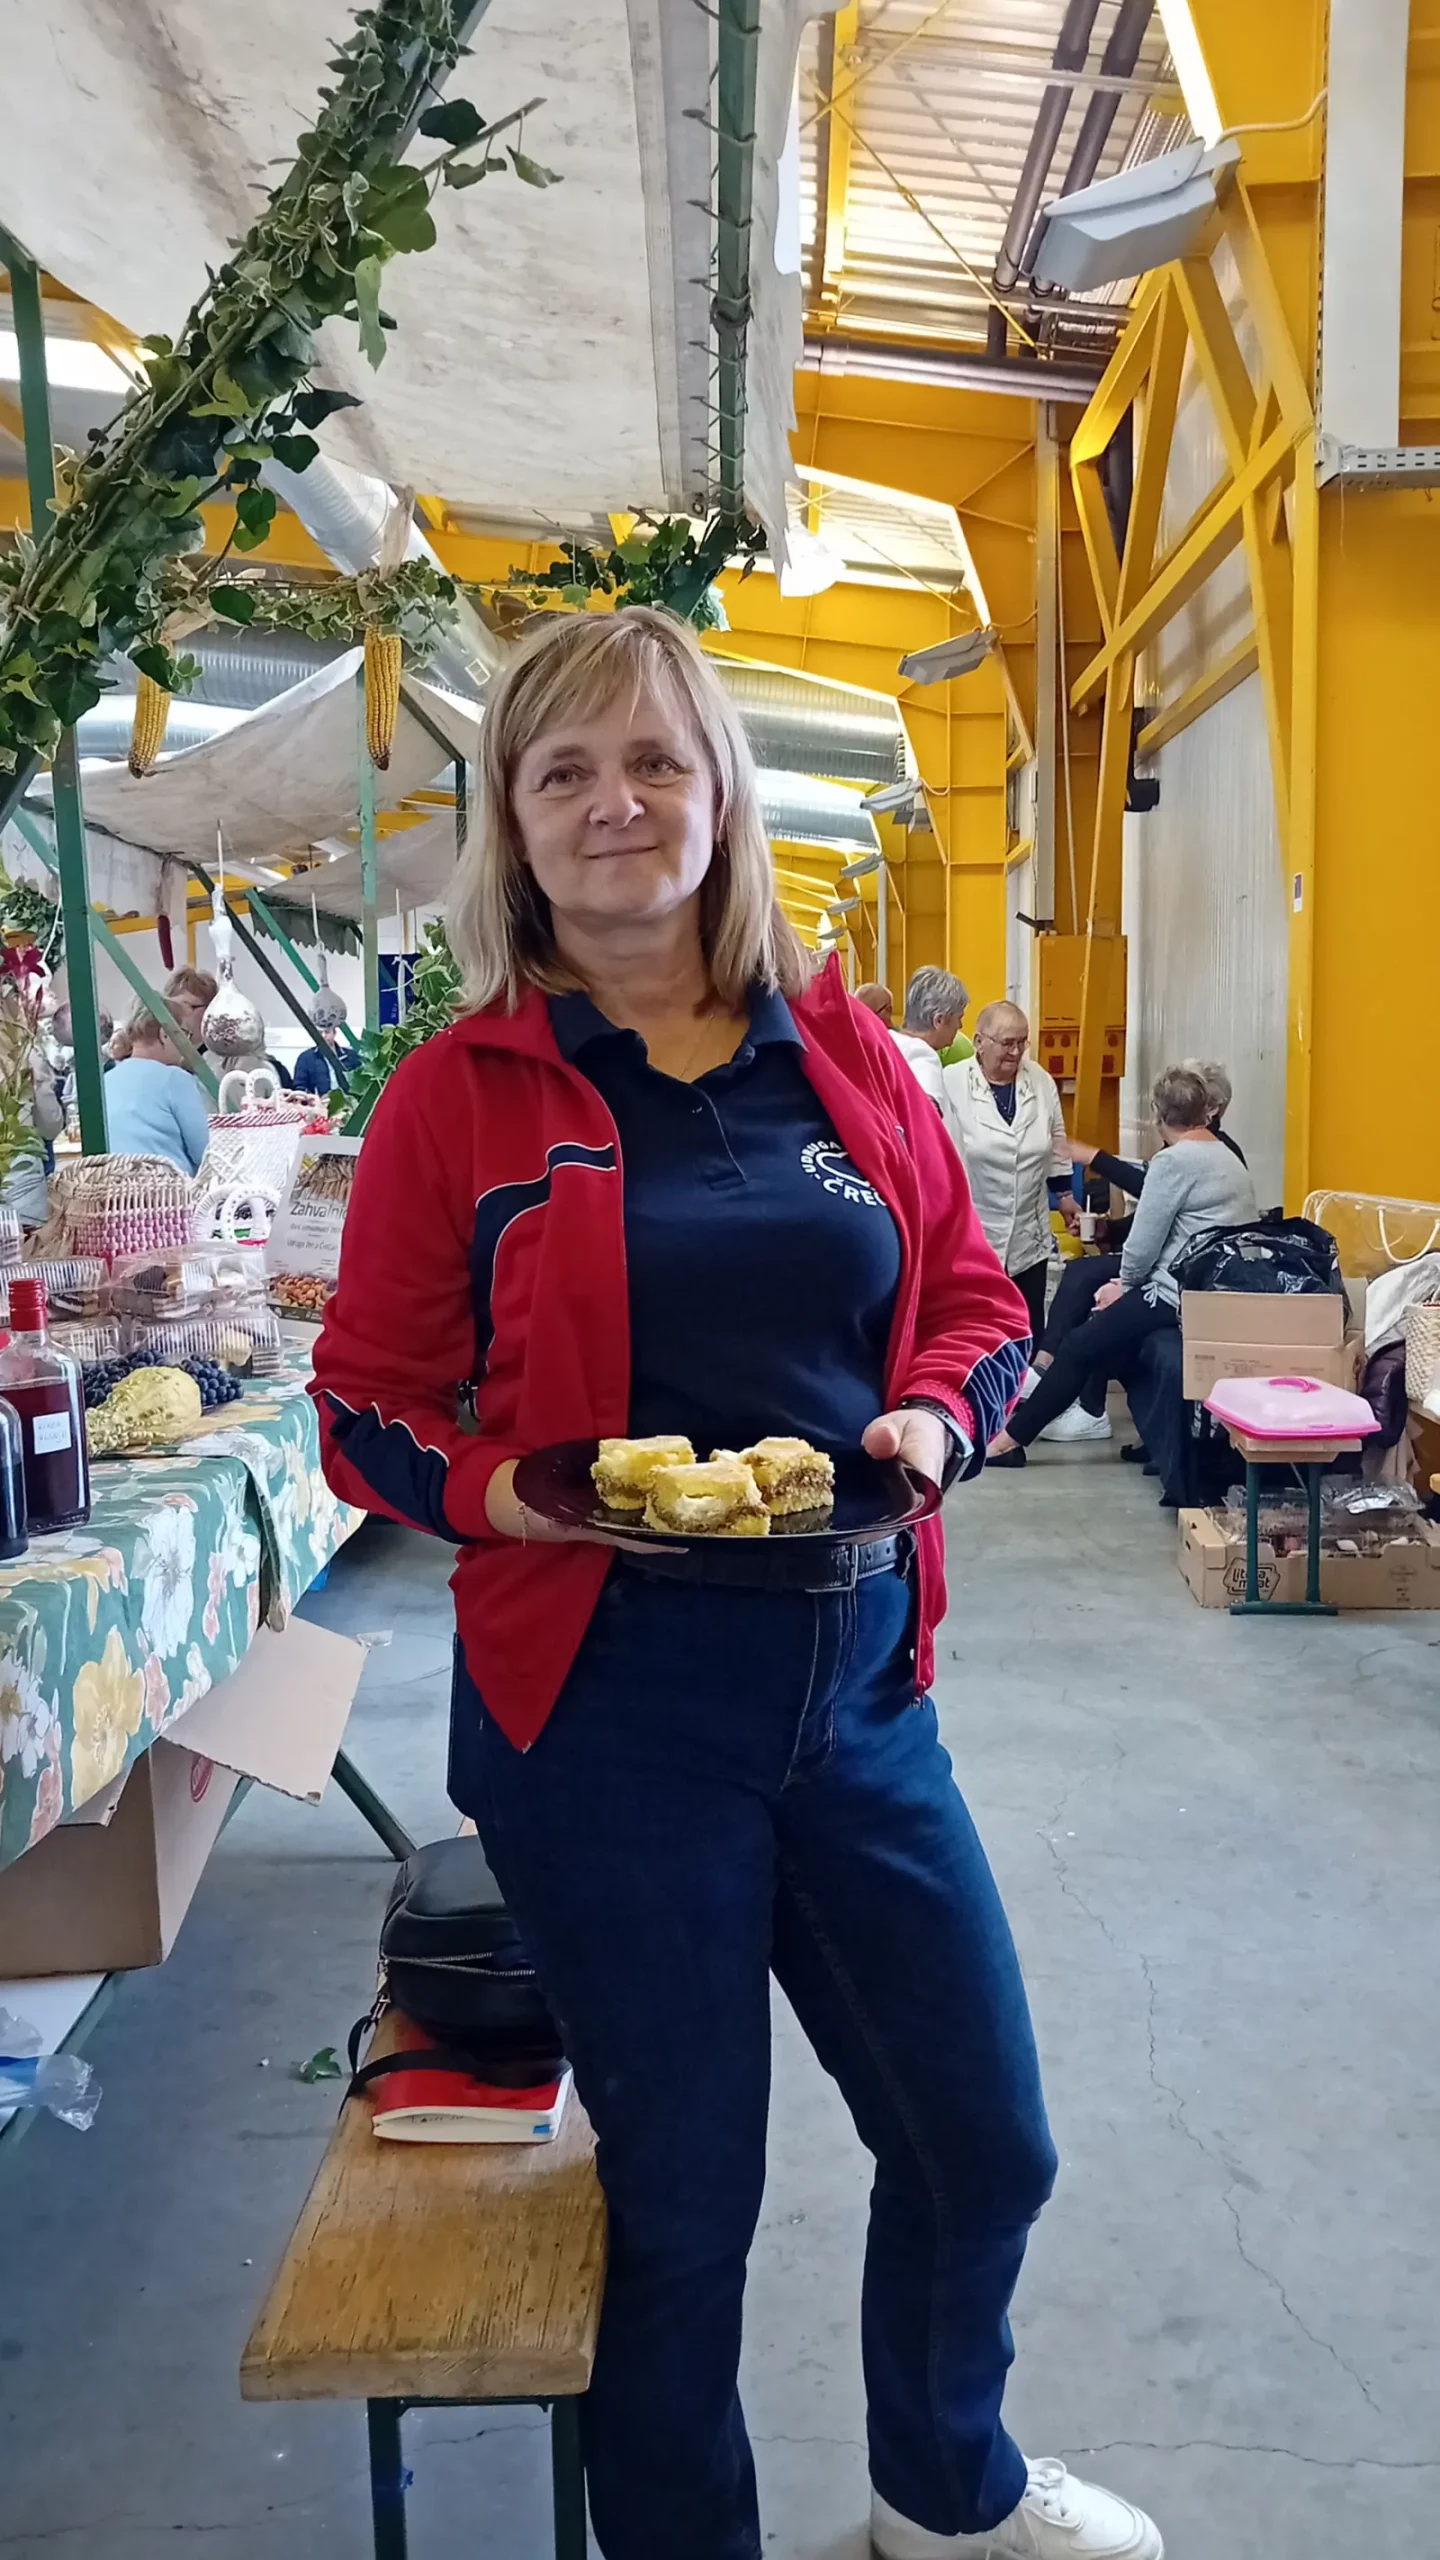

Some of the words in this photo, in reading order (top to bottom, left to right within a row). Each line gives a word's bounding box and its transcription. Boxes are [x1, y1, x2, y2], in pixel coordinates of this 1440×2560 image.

[800, 1140, 842, 1173] UDRUGA
[1232, 1568, 1266, 1582] lita
[1238, 1576, 1271, 1588] mat
